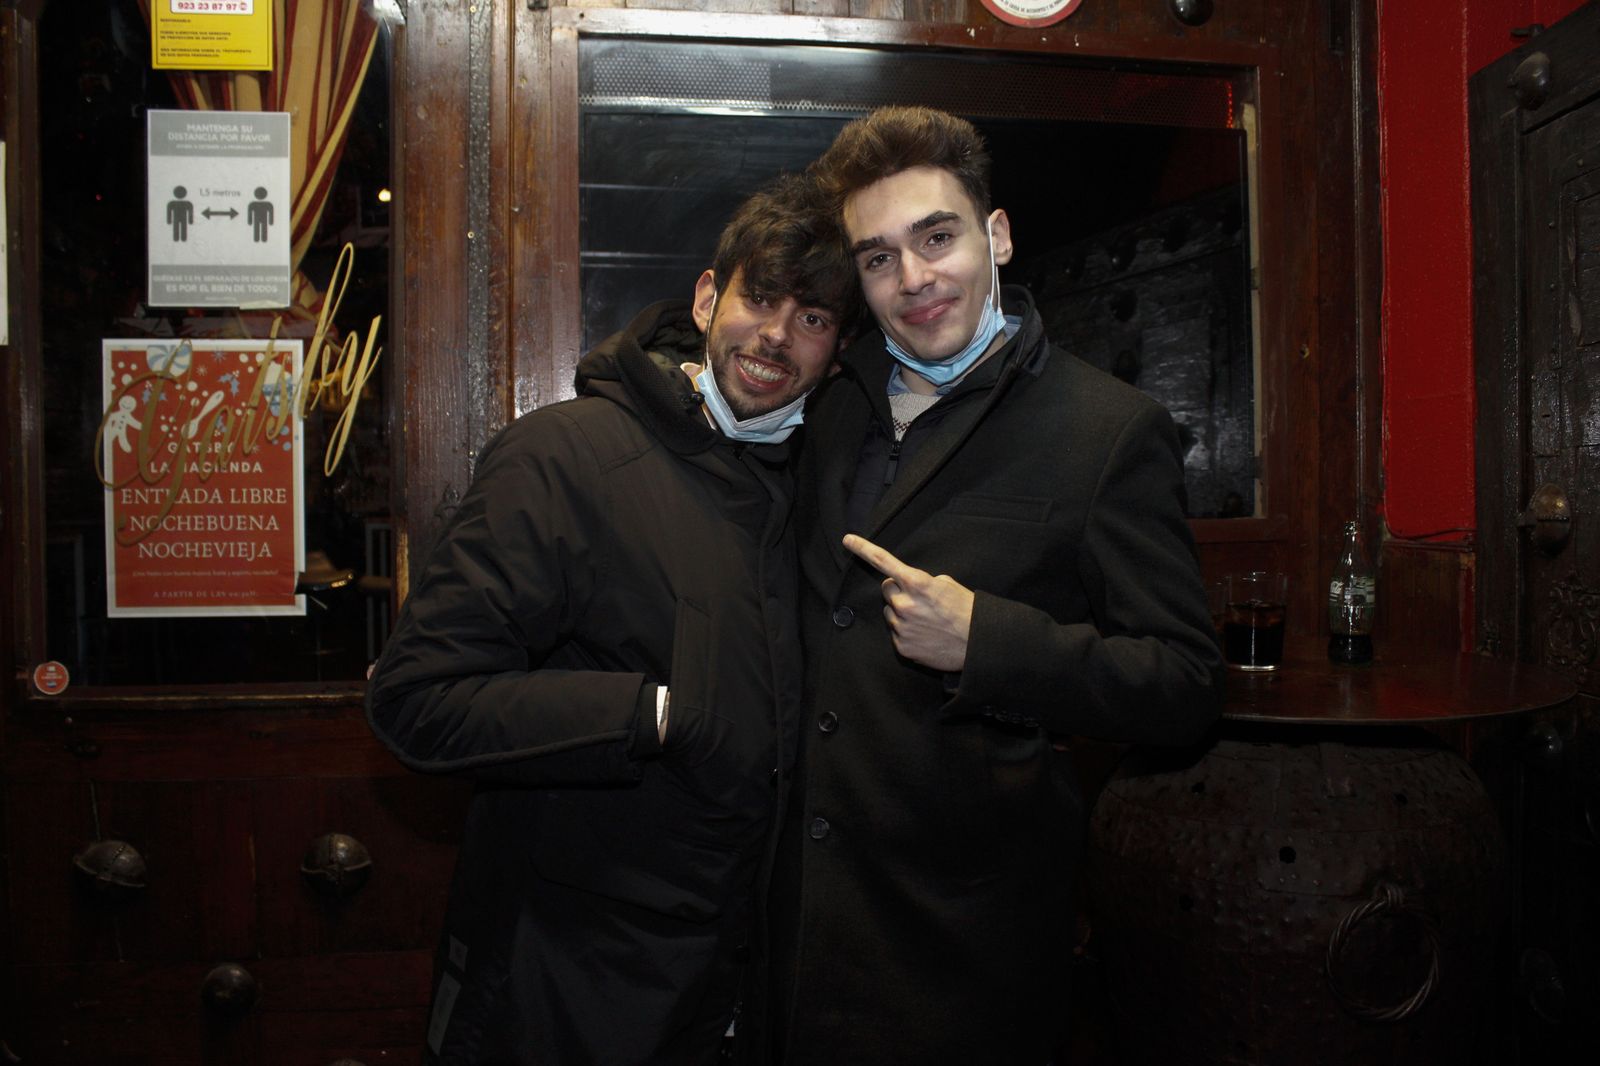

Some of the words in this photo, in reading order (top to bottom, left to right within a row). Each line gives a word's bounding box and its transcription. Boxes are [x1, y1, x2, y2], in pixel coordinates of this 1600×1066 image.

[178, 2, 196, 10] 923
[197, 2, 210, 10] 23
[211, 3, 223, 11] 87
[225, 3, 238, 11] 97
[186, 124, 239, 133] MANTENGA
[241, 125, 254, 133] SU
[168, 132, 218, 142] DISTANCIA
[220, 133, 238, 142] POR
[240, 133, 271, 143] FAVOR
[212, 189, 241, 197] metros
[166, 283, 178, 293] ES
[179, 283, 198, 293] POR
[199, 283, 210, 293] EL
[211, 283, 232, 293] BIEN
[233, 284, 245, 293] DE
[247, 284, 279, 294] TODOS
[167, 441, 234, 454] GTB
[150, 461, 170, 473] LA
[229, 487, 288, 505] LIBRE
[129, 515, 280, 532] NOCHEBUENA
[138, 542, 273, 561] NOCHEVIEJA
[196, 591, 208, 599] DE
